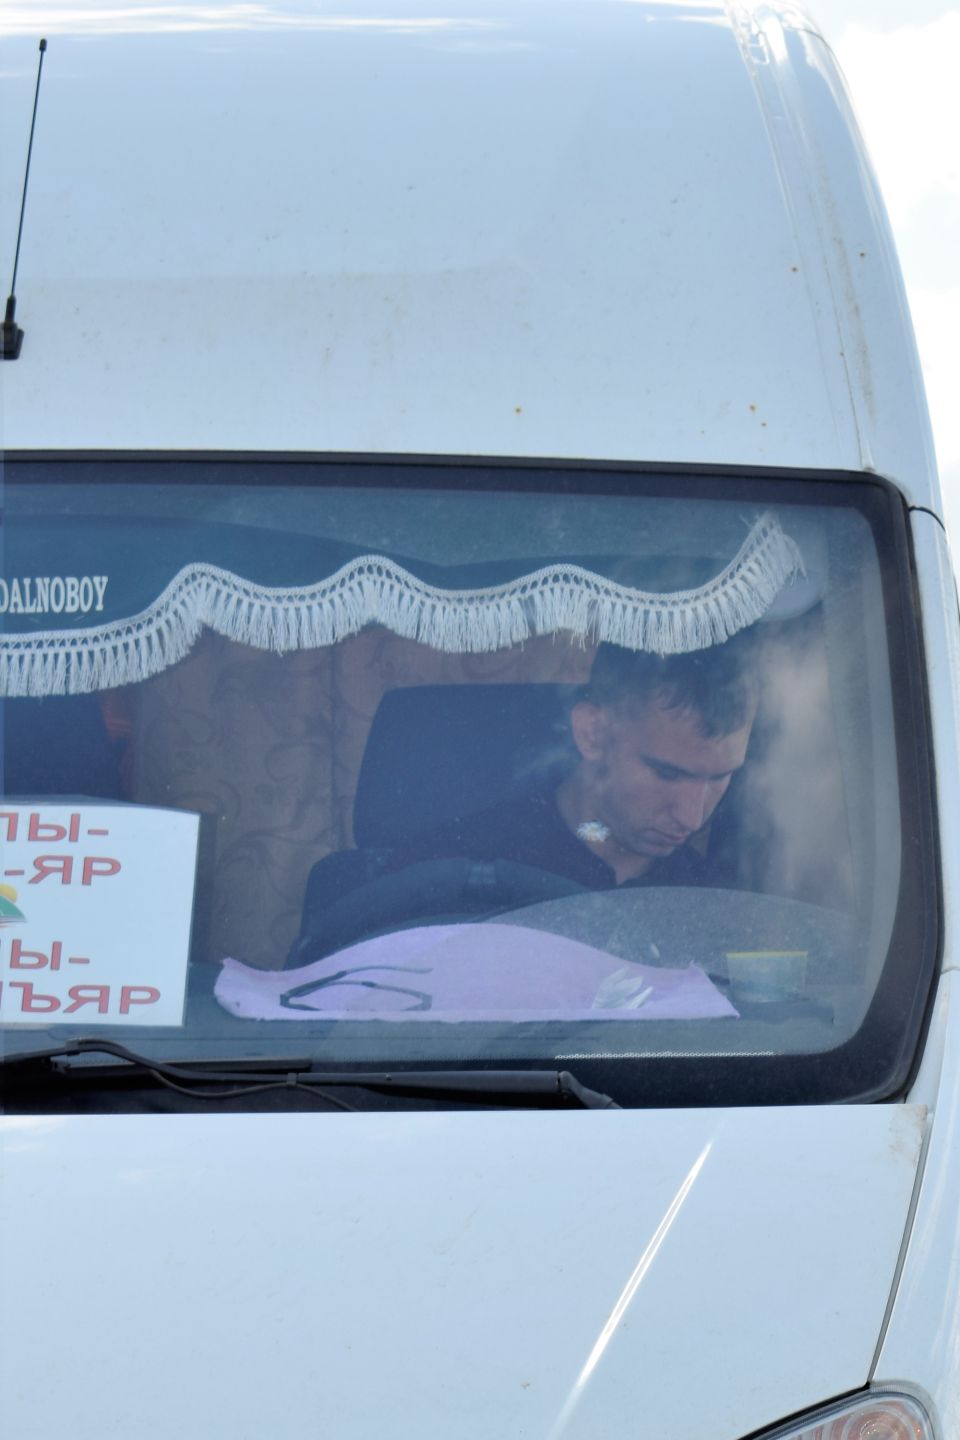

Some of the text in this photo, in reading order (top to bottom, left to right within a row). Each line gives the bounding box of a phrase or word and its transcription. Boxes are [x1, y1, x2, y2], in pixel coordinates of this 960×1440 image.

[0, 576, 108, 613] DALNOBOY
[0, 938, 90, 971] Ы-
[0, 981, 161, 1015] ЪЯР
